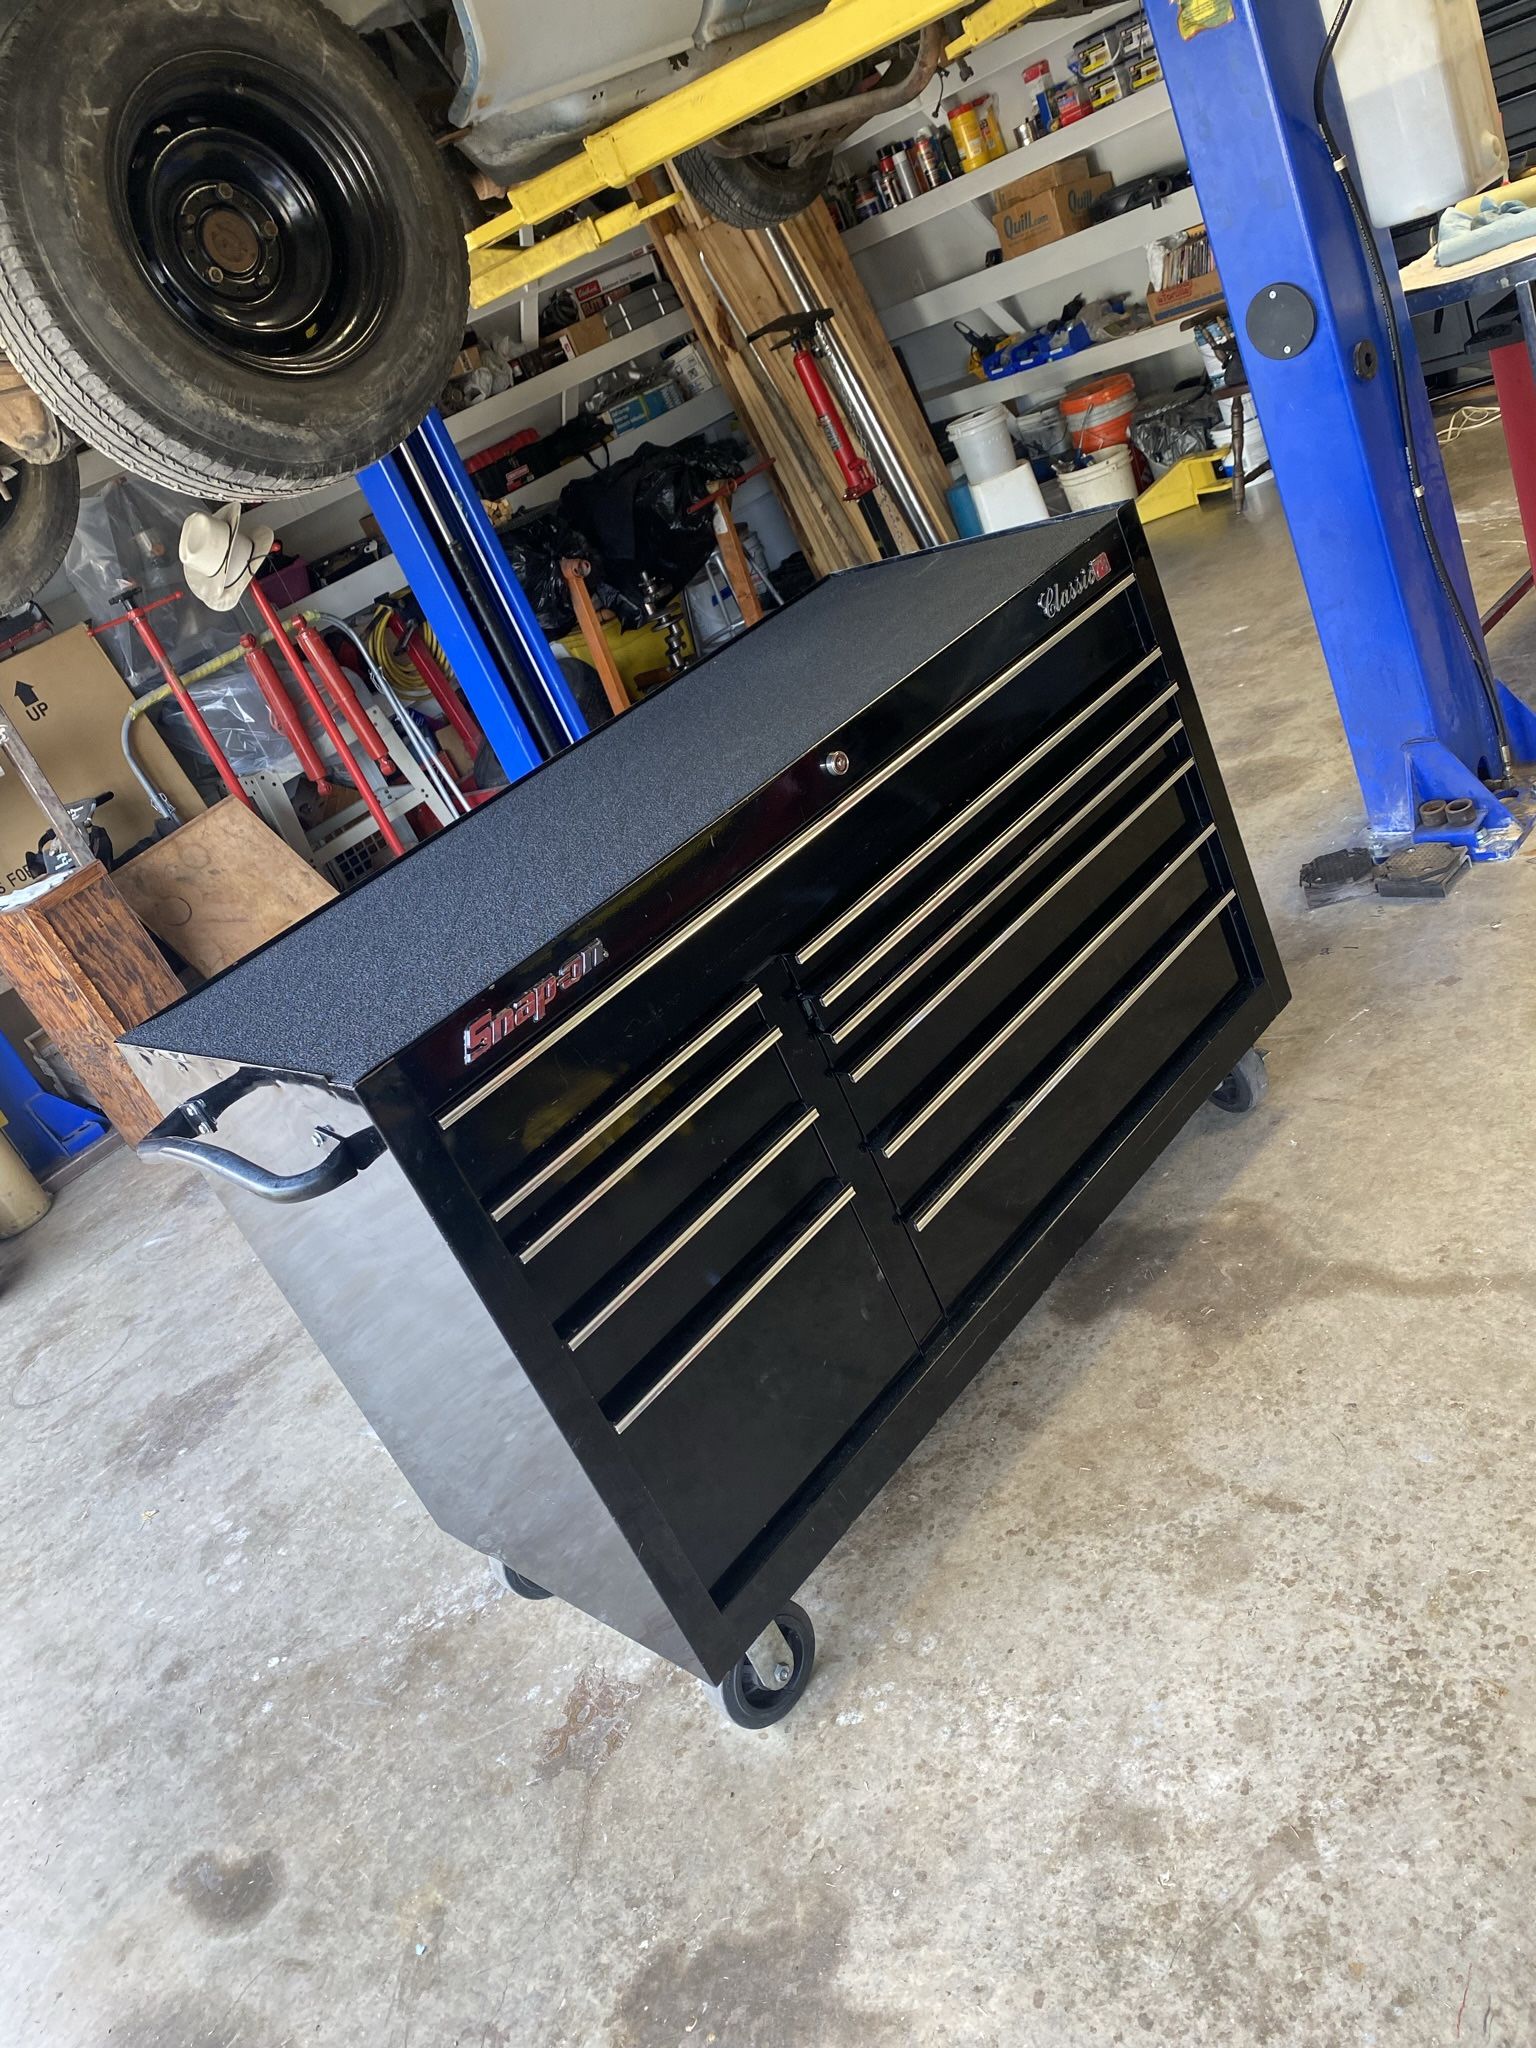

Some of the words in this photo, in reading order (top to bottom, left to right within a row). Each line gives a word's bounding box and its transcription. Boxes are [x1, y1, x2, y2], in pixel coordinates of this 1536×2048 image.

[1004, 209, 1048, 239] Quill.com
[1037, 562, 1098, 618] Classic
[25, 702, 48, 721] UP
[463, 938, 608, 1065] Snap-on
